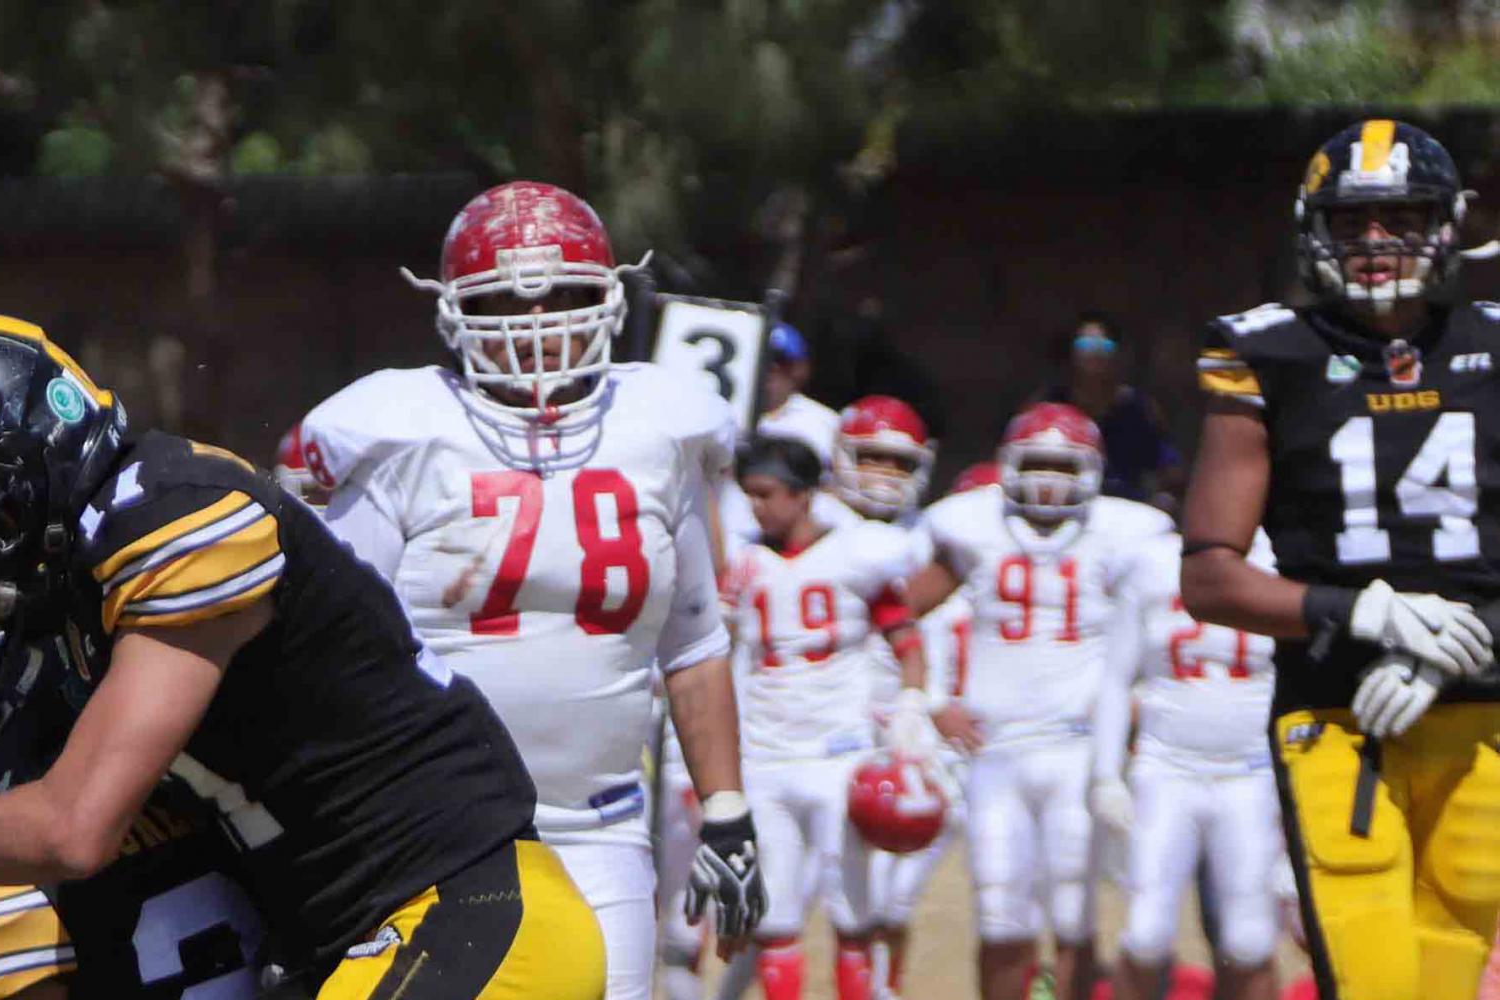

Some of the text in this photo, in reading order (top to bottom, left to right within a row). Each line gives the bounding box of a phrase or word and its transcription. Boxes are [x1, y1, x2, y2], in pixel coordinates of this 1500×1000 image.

[683, 326, 736, 403] 3
[1367, 391, 1440, 413] UDG
[1329, 412, 1480, 563] 14
[470, 468, 650, 635] 78
[752, 583, 838, 669] 19
[997, 555, 1080, 641] 91
